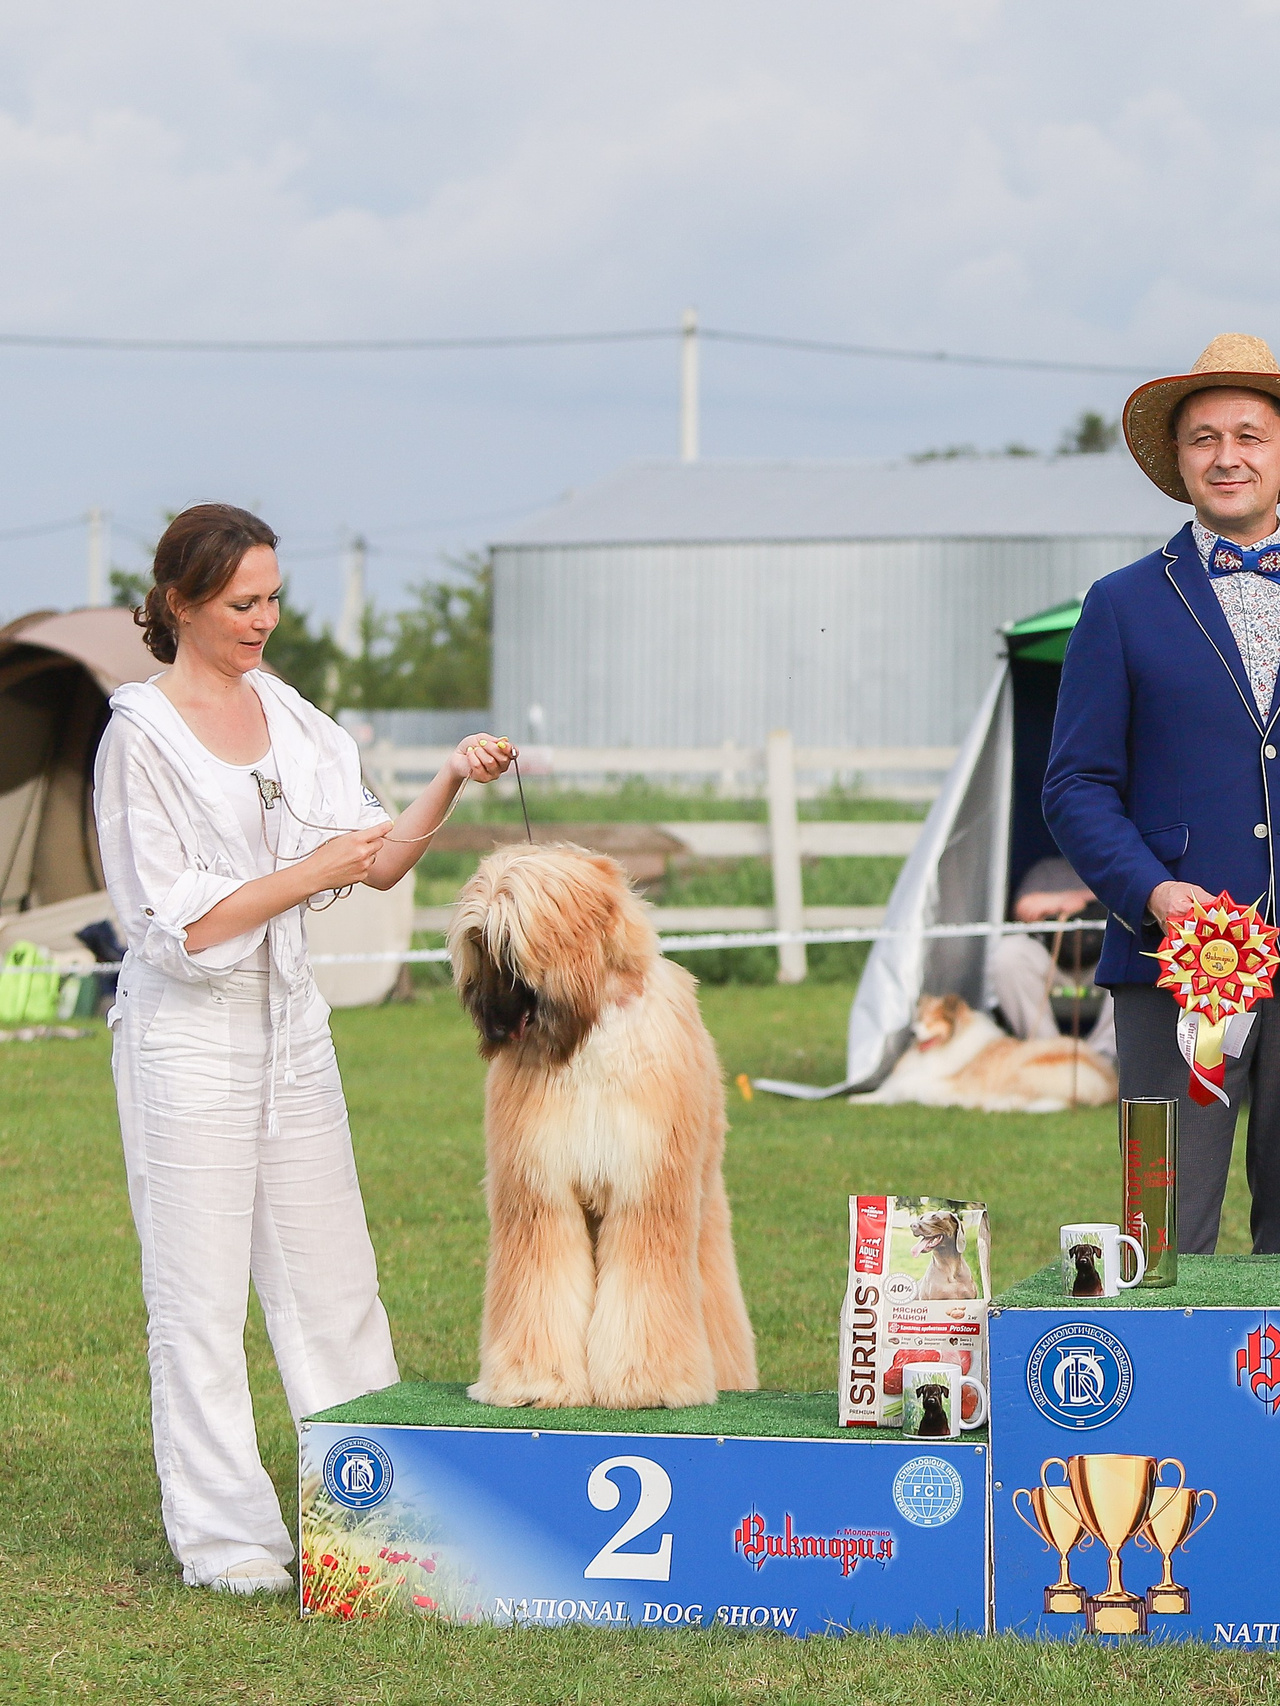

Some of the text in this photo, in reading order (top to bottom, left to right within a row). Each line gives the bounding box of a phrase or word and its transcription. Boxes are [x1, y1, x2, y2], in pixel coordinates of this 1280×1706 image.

[1128, 1139, 1143, 1250] ИКТОРИЯ
[858, 1245, 880, 1258] ADULT
[889, 1283, 912, 1294] 40%
[892, 1306, 928, 1314] МЯСНОЙ
[892, 1313, 926, 1321] РАЦИОН
[849, 1285, 880, 1406] SIRIUS
[1040, 1326, 1115, 1350] КИНОЛОГИЧЕСКОЕ
[899, 1458, 947, 1480] CYNOLOGIQUE
[895, 1480, 918, 1522] FEDERATION
[913, 1485, 942, 1497] FCI
[583, 1454, 674, 1582] 2
[735, 1503, 895, 1578] Виктория
[843, 1528, 891, 1538] Молодечно
[494, 1597, 798, 1628] NATIONAL DOG SHOW
